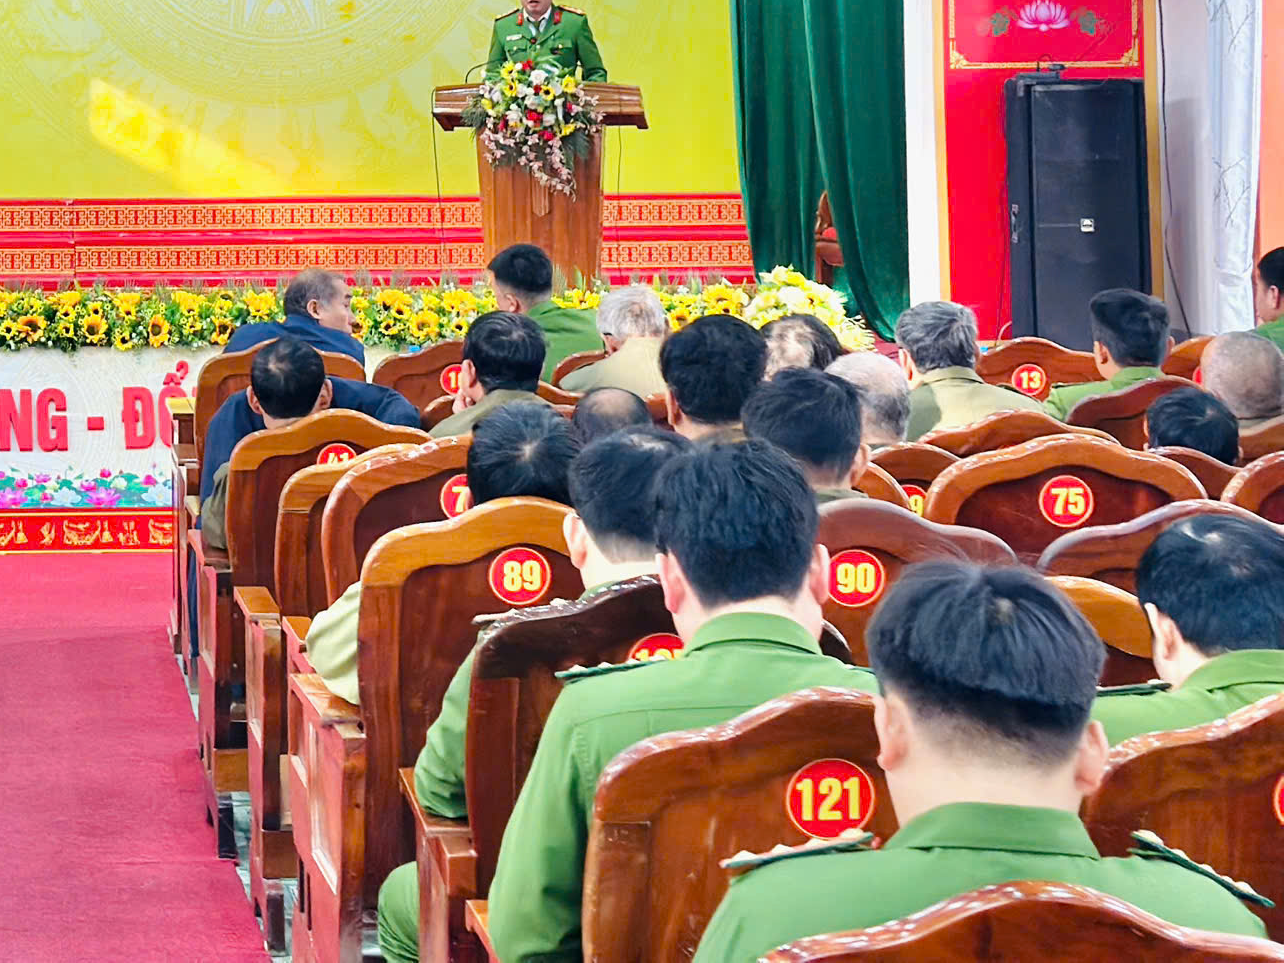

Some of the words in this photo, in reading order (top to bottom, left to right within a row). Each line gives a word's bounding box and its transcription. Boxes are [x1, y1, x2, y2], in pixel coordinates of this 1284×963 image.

[1021, 370, 1041, 389] 13
[122, 360, 198, 450] ĐỔ
[1052, 487, 1084, 515] 75
[503, 560, 544, 592] 89
[836, 561, 876, 593] 90
[796, 777, 860, 821] 121
